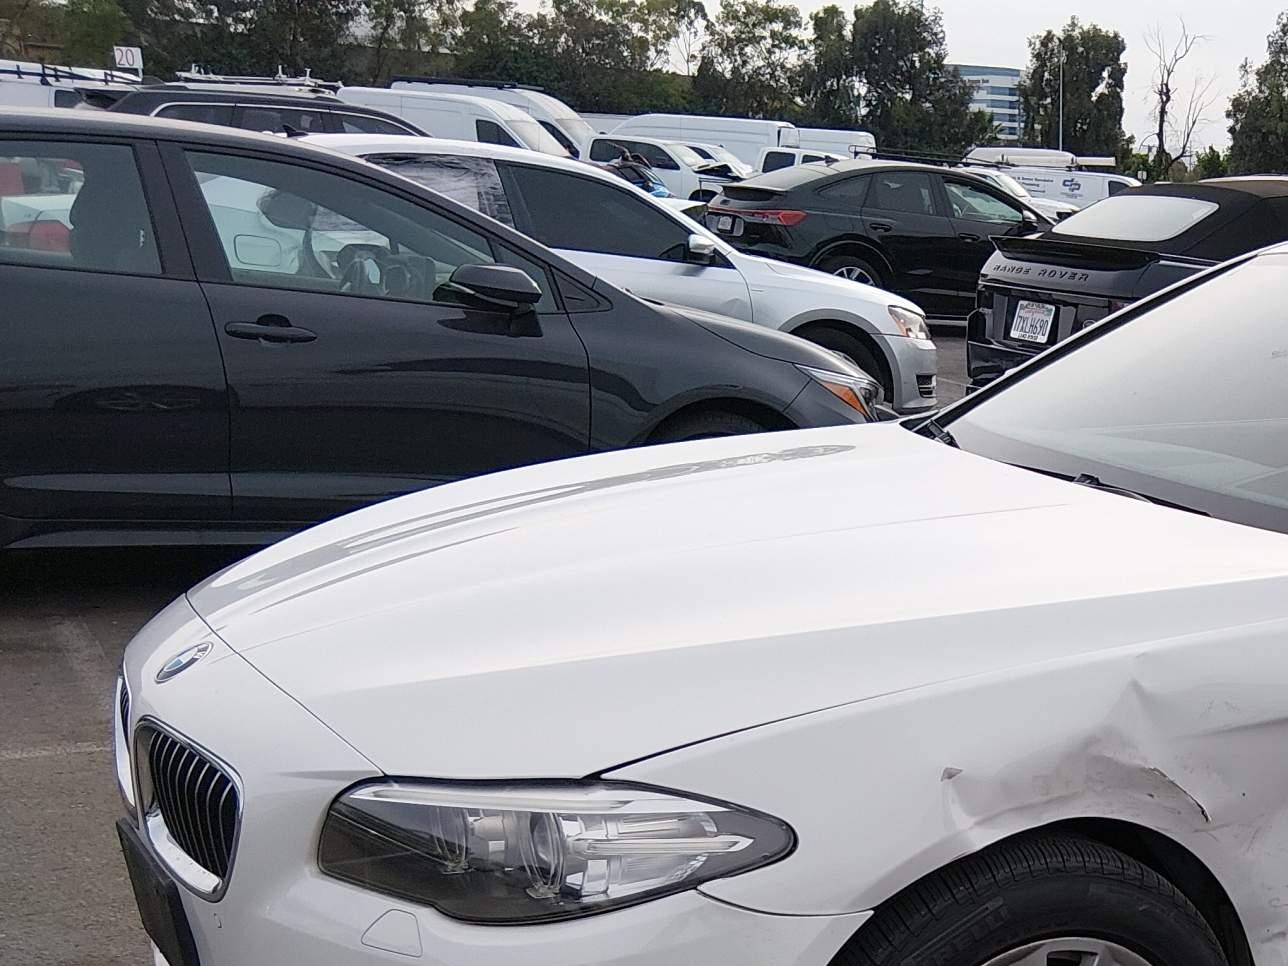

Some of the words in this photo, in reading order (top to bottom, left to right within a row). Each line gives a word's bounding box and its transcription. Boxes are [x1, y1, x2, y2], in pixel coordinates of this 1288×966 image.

[116, 48, 135, 66] 20
[993, 264, 1032, 275] RANGE
[1038, 268, 1089, 282] ROVER
[1015, 316, 1049, 336] 7XLH690
